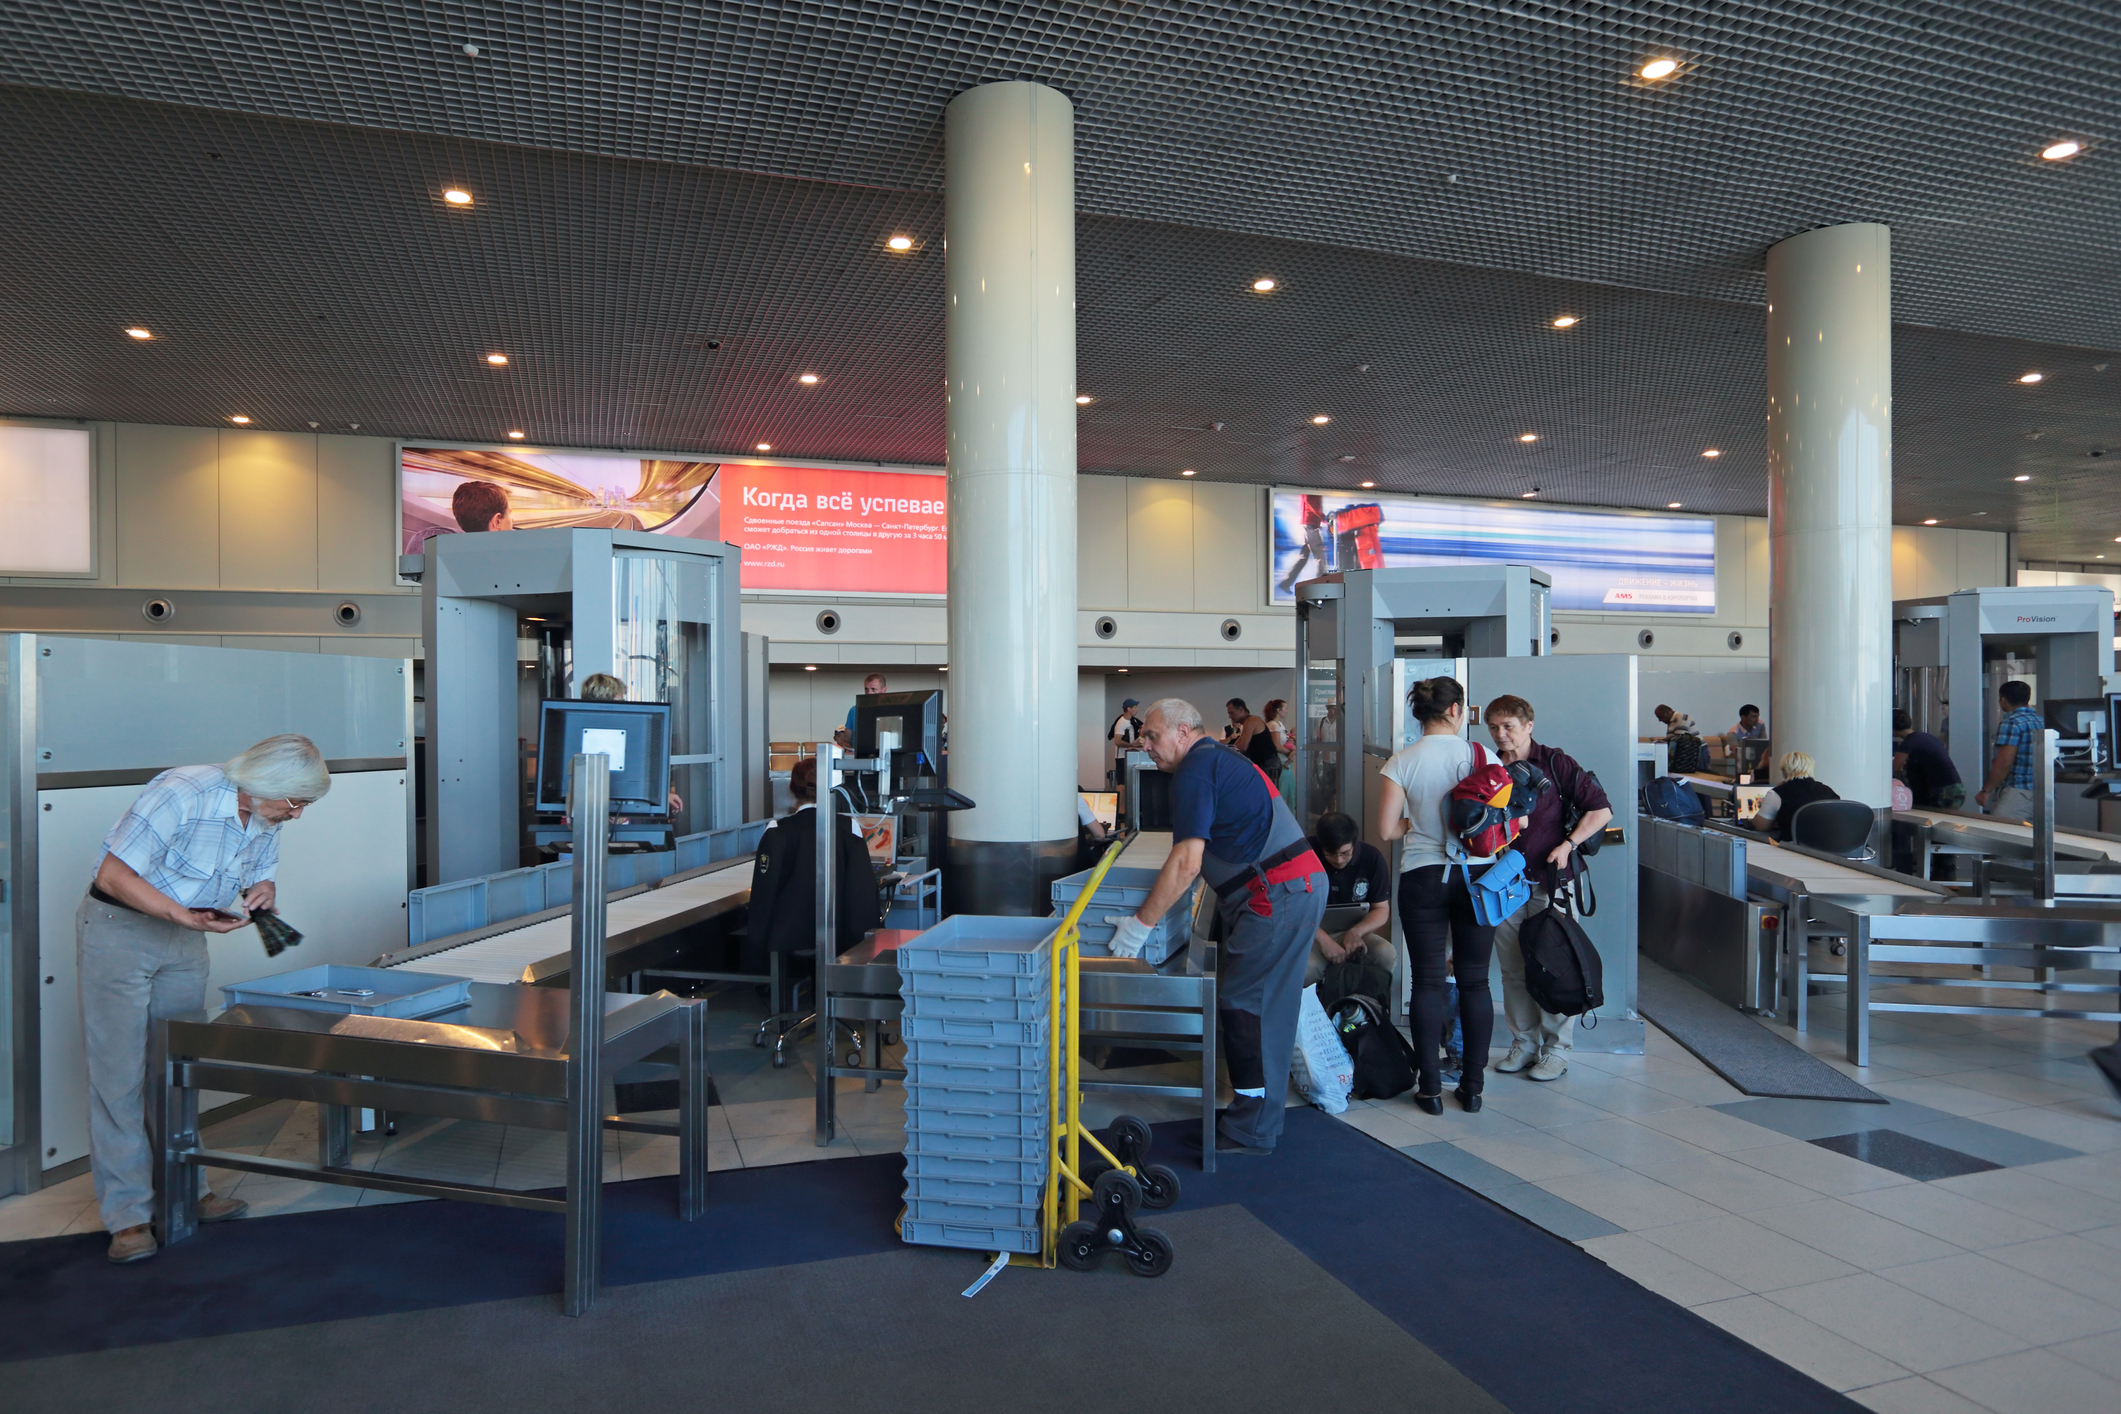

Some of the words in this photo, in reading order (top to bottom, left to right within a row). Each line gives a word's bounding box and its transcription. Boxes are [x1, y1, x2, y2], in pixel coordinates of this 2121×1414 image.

[743, 486, 808, 511] Когда
[816, 491, 853, 511] всё
[743, 516, 785, 525] Сдвоенные
[786, 519, 811, 527] поезда
[812, 519, 845, 528] «Сапсан»
[846, 521, 873, 529] Москва
[881, 522, 940, 533] Санкт-Петербург.
[743, 526, 771, 534] сможет
[772, 526, 809, 535] добраться
[819, 528, 841, 537] одной
[842, 530, 872, 538] столицы
[878, 532, 903, 540] другую
[790, 545, 815, 553] Россия
[815, 546, 837, 554] живет
[837, 547, 873, 555] дорогами
[743, 560, 785, 568] www.rzd.ru
[1617, 577, 1662, 587] ДВИЖЕНИЕ
[1670, 579, 1698, 588] ЖИЗНЬ
